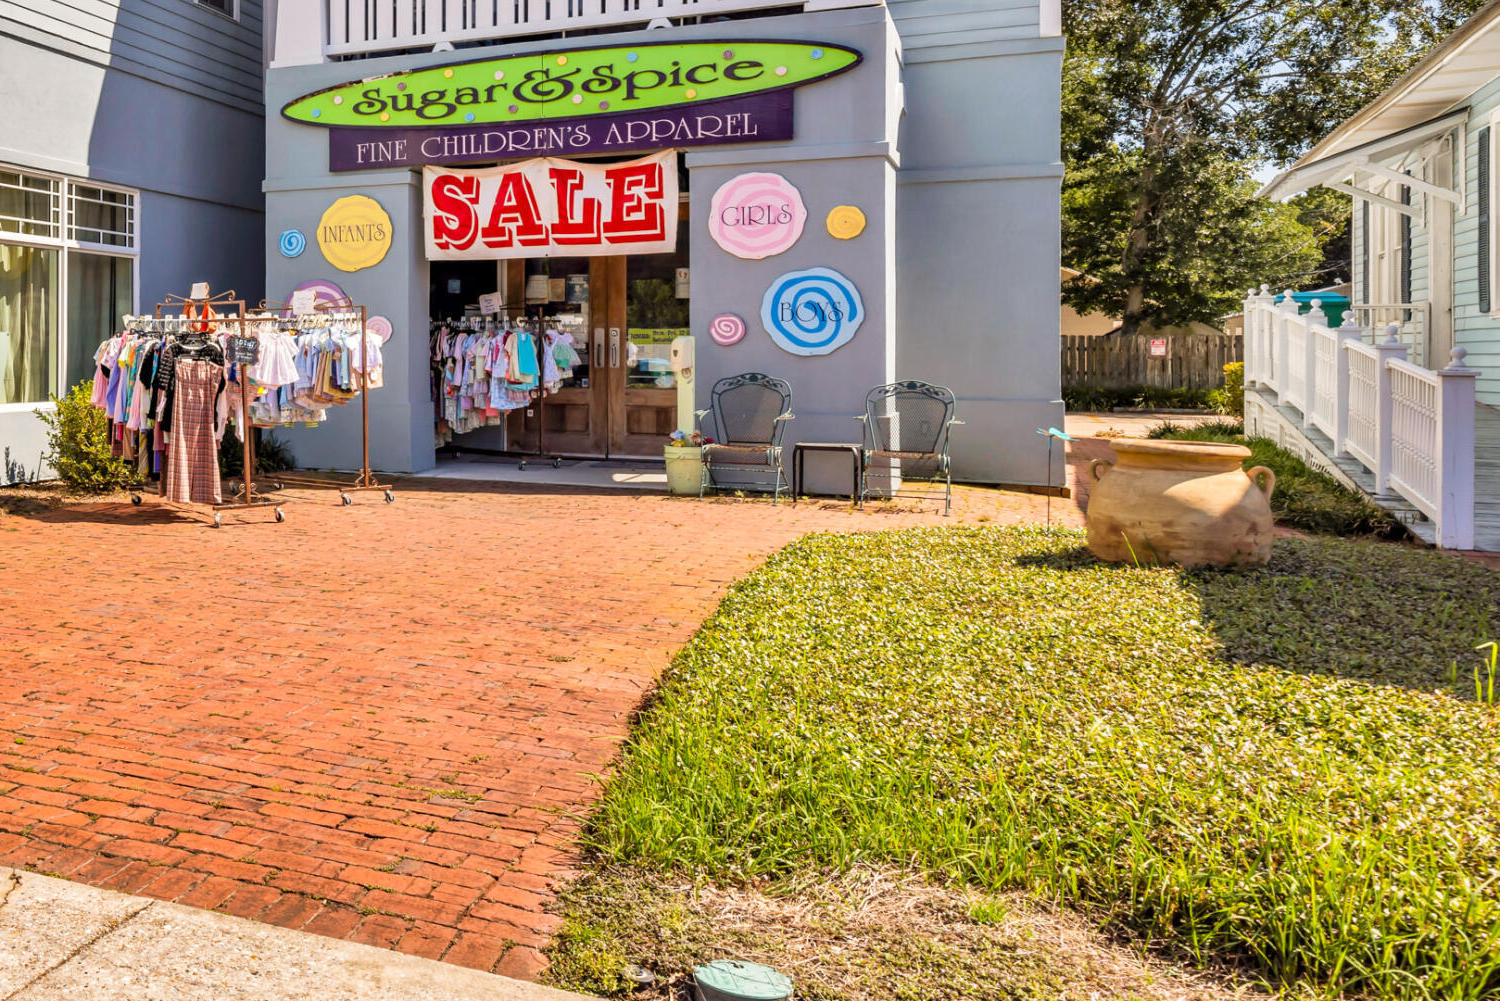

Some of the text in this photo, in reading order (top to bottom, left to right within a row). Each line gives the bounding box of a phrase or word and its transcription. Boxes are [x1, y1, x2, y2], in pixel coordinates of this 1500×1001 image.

[352, 59, 766, 120] Sugar & Spice
[356, 112, 759, 164] FINE CHILDREN'S APPAREL
[431, 162, 666, 251] SALE
[721, 203, 793, 227] GIRLS
[323, 223, 386, 243] INFANTS
[780, 301, 844, 323] BOYS
